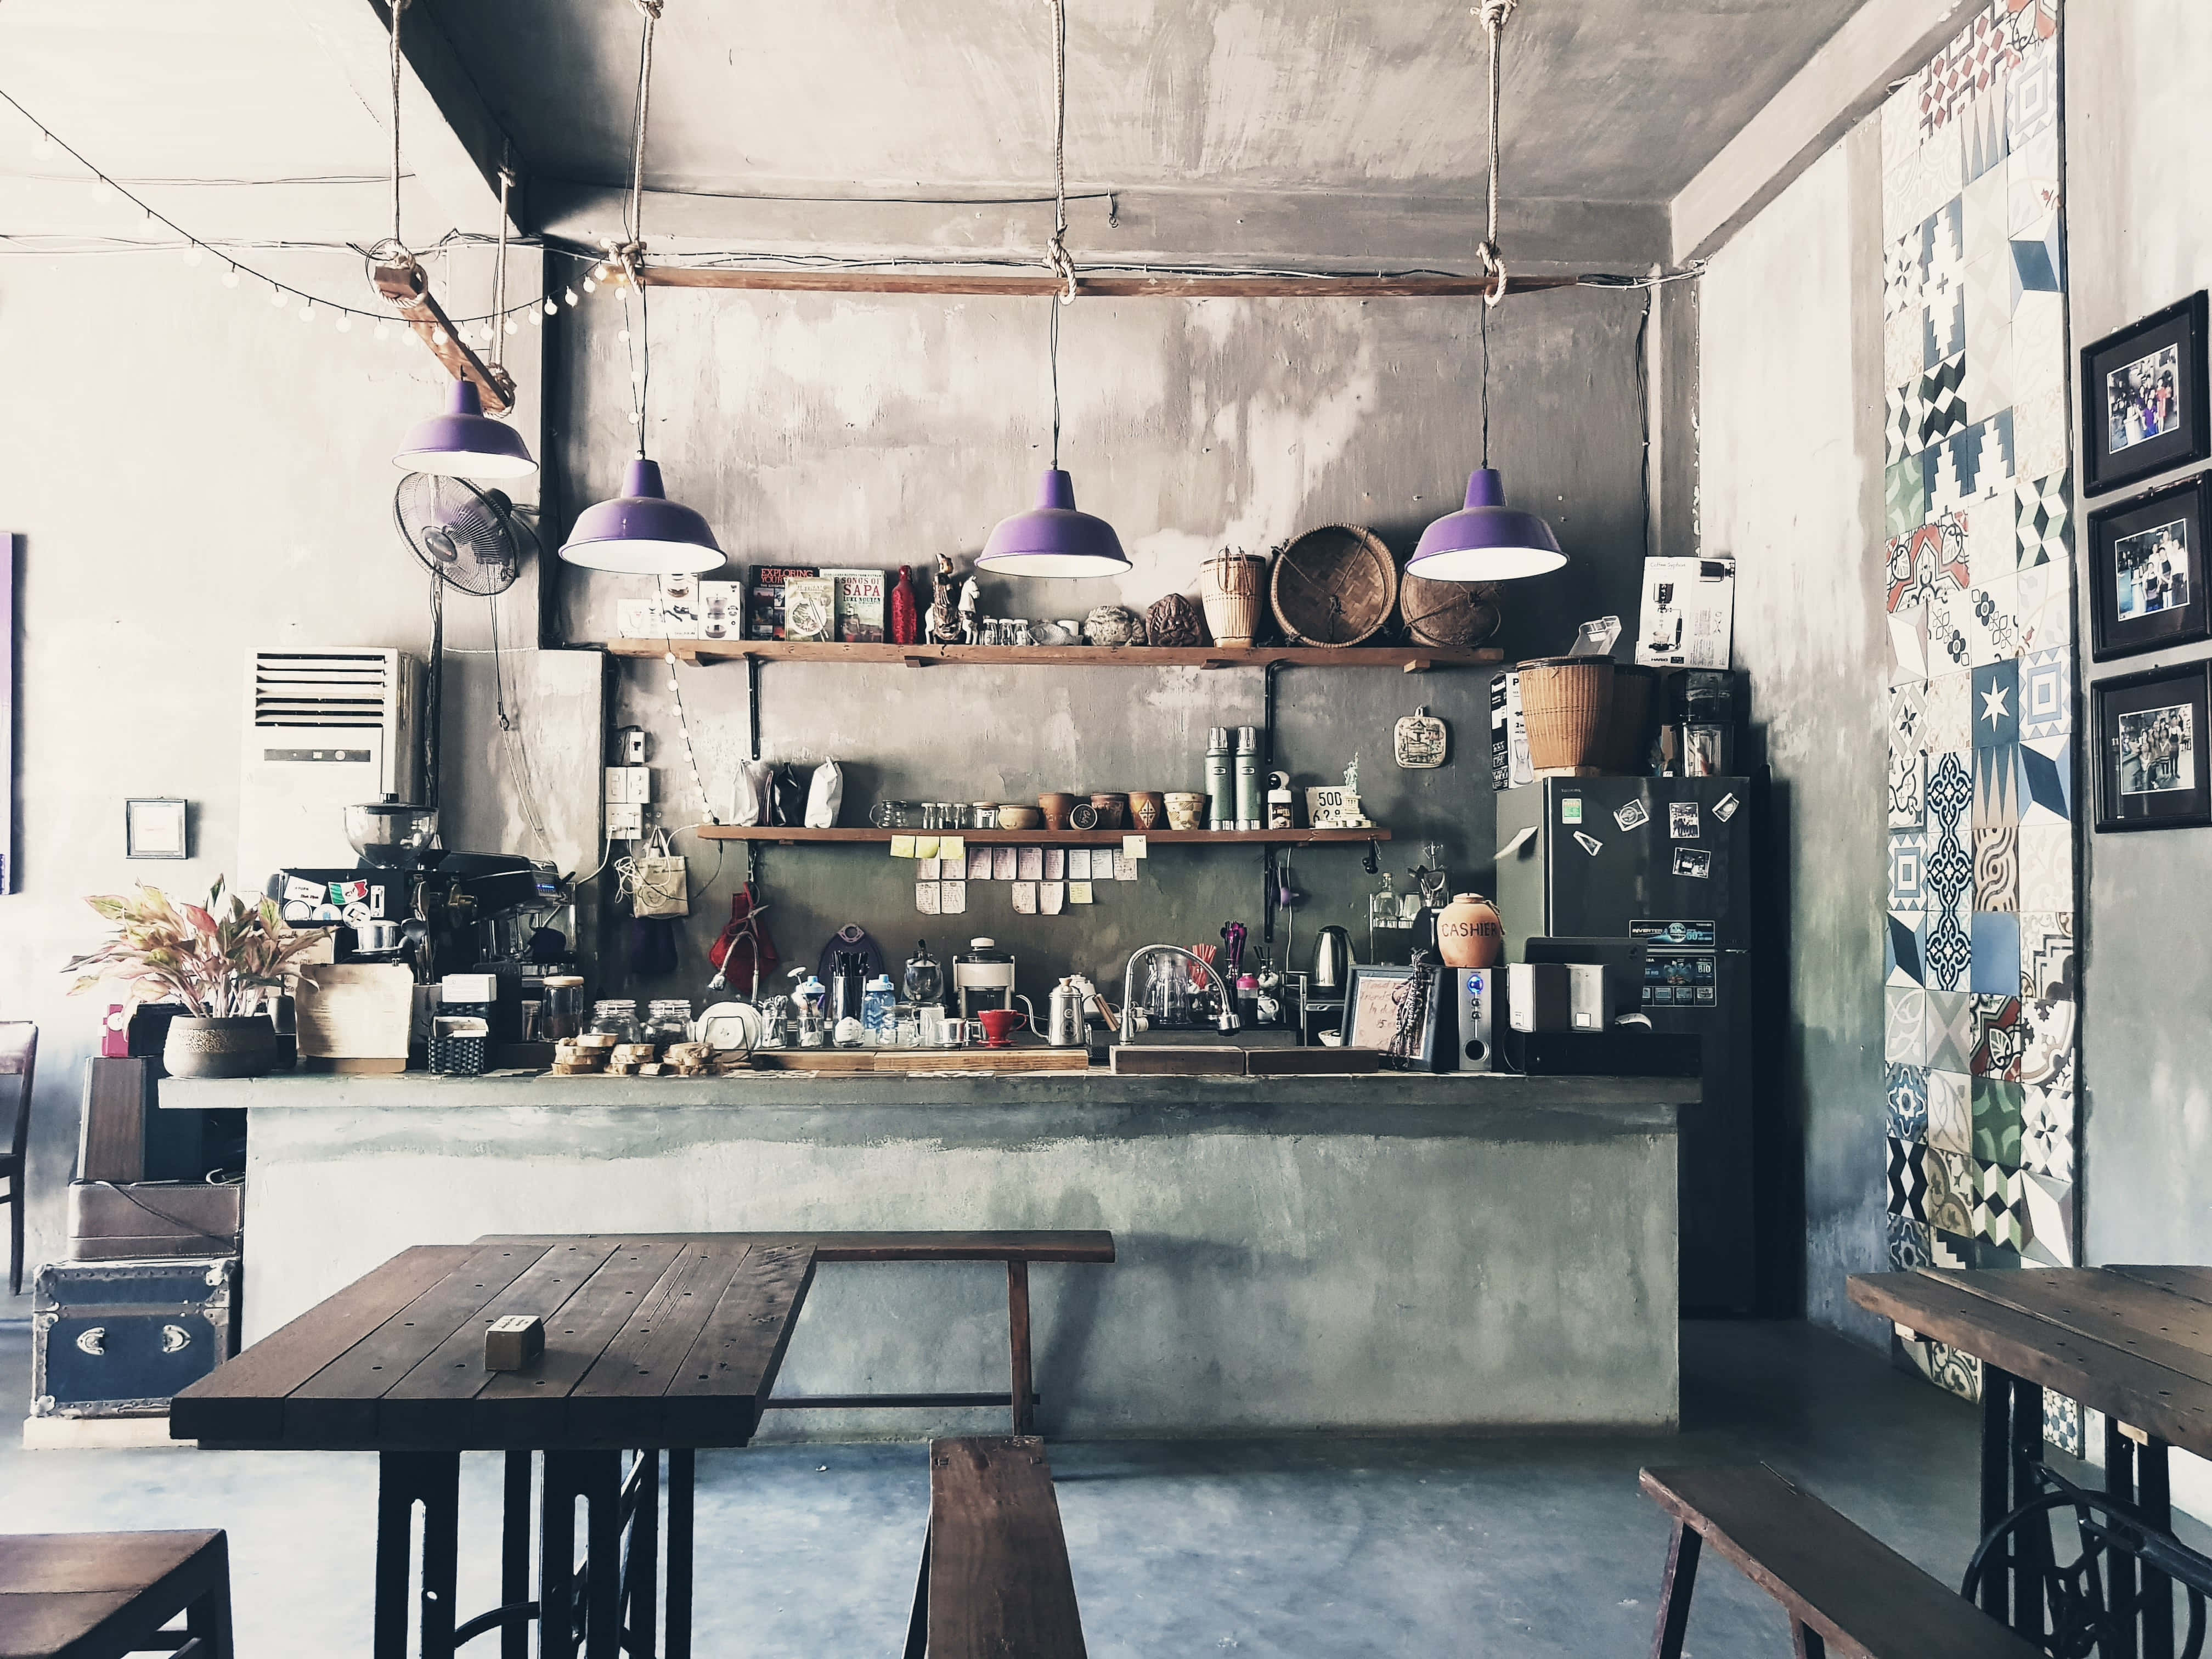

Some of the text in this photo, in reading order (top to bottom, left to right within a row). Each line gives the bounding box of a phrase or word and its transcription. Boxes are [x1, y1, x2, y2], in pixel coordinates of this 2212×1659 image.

[761, 568, 813, 578] EXPLORING
[841, 577, 869, 585] SONGS
[843, 584, 881, 597] SAPA
[1318, 791, 1342, 806] 50D
[1441, 922, 1497, 937] CASHIER
